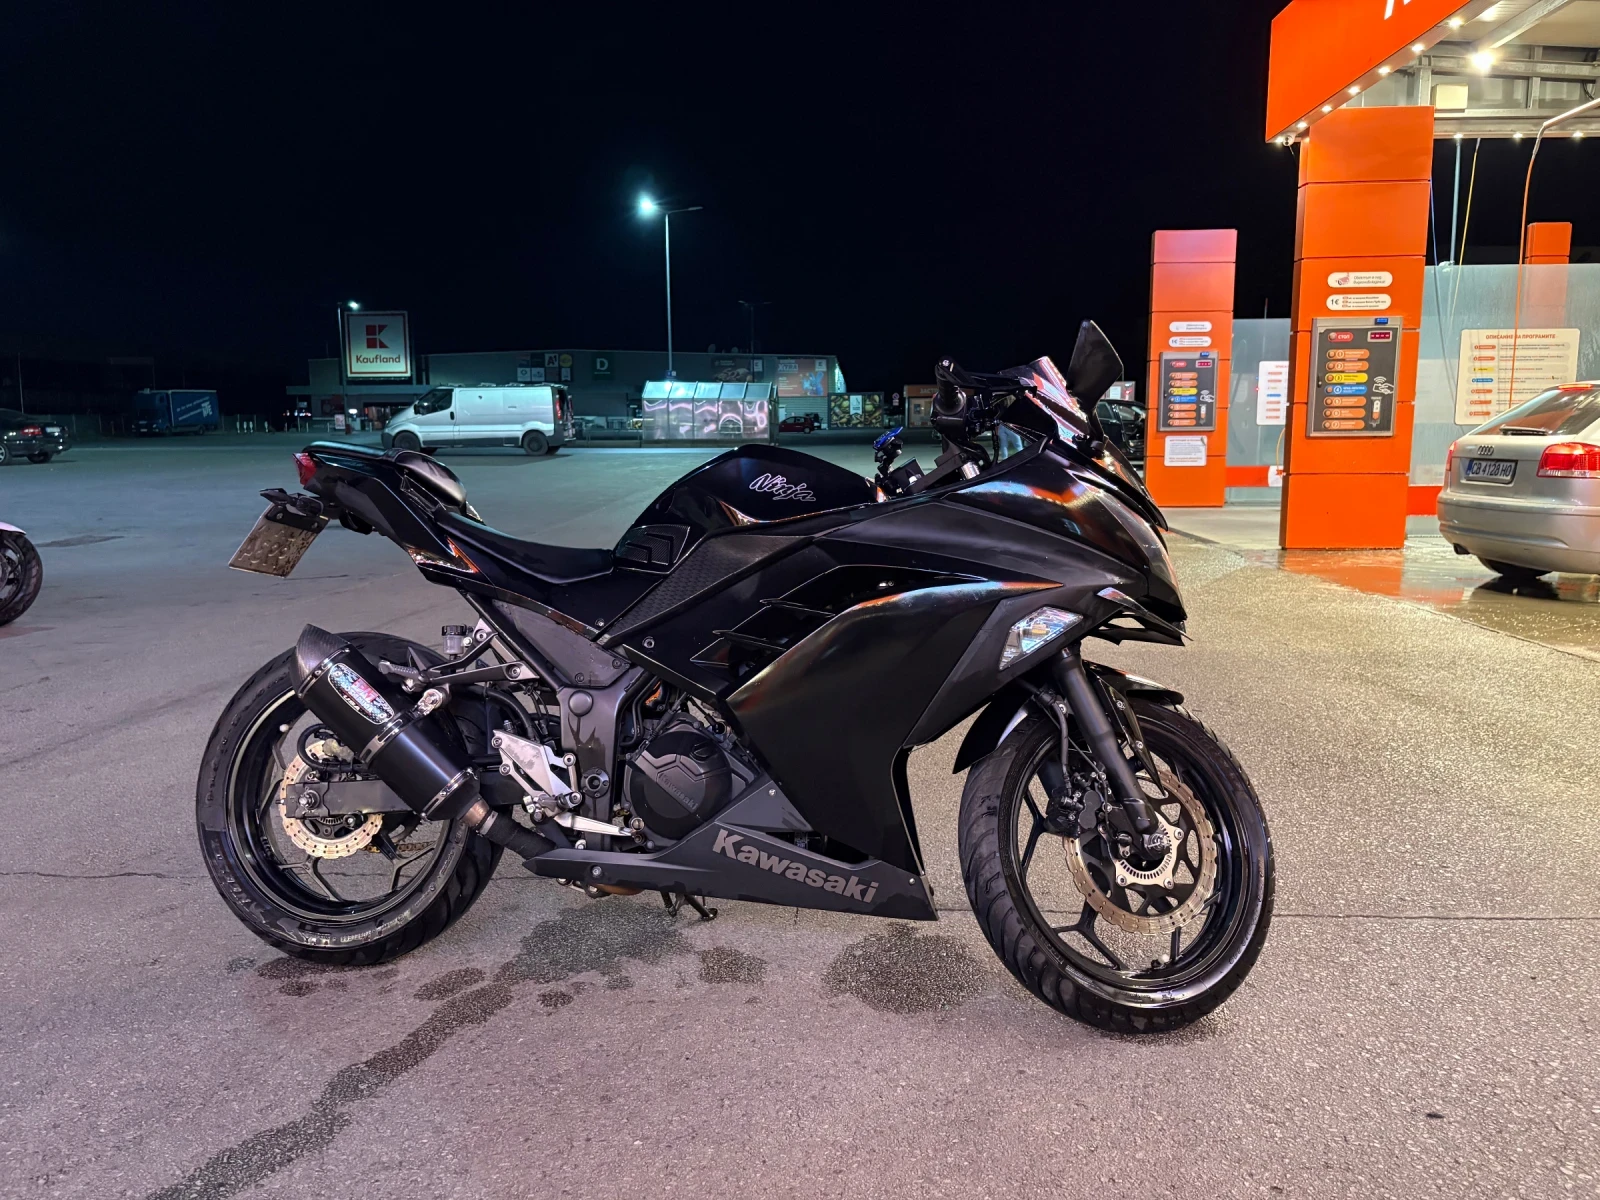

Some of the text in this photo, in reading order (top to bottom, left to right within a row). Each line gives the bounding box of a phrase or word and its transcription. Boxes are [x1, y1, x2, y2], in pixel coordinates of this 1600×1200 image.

[356, 354, 401, 364] Kaufland
[596, 358, 609, 371] D
[1471, 462, 1482, 475] CB
[1482, 463, 1501, 476] 4128
[749, 473, 817, 502] Ninja
[658, 773, 699, 810] Kawasaki
[712, 828, 880, 903] Kawasaki
